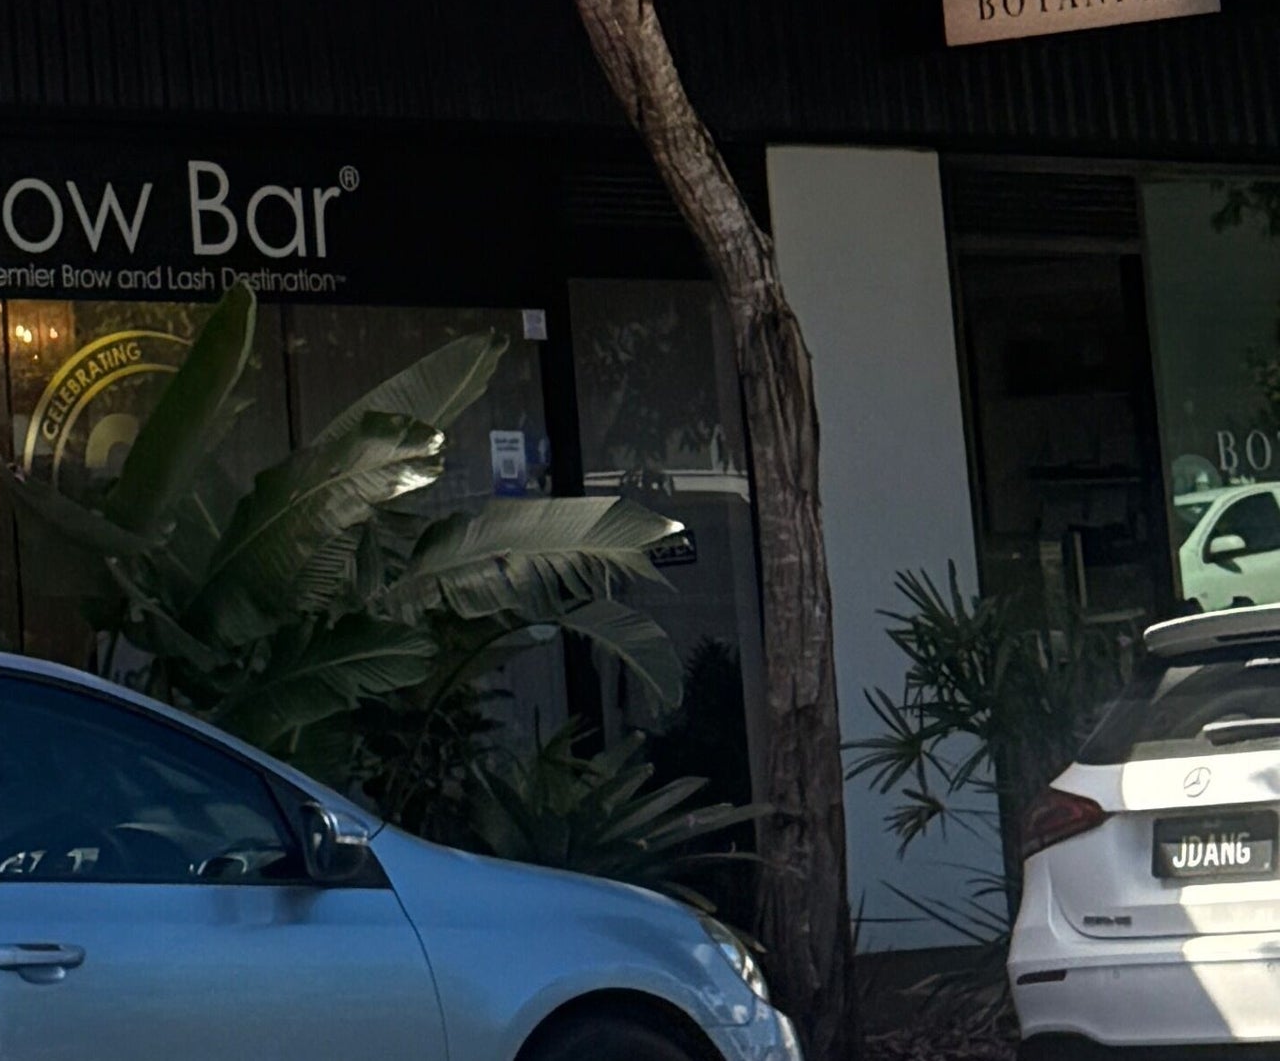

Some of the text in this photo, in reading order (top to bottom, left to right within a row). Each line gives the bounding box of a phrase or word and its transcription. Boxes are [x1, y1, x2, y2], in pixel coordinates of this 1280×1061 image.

[62, 264, 113, 289] Brow
[117, 266, 161, 290] and
[167, 266, 215, 290] Lash
[41, 340, 142, 440] CELEBRATING
[1216, 429, 1280, 472] BO
[1172, 830, 1251, 869] JDANG
